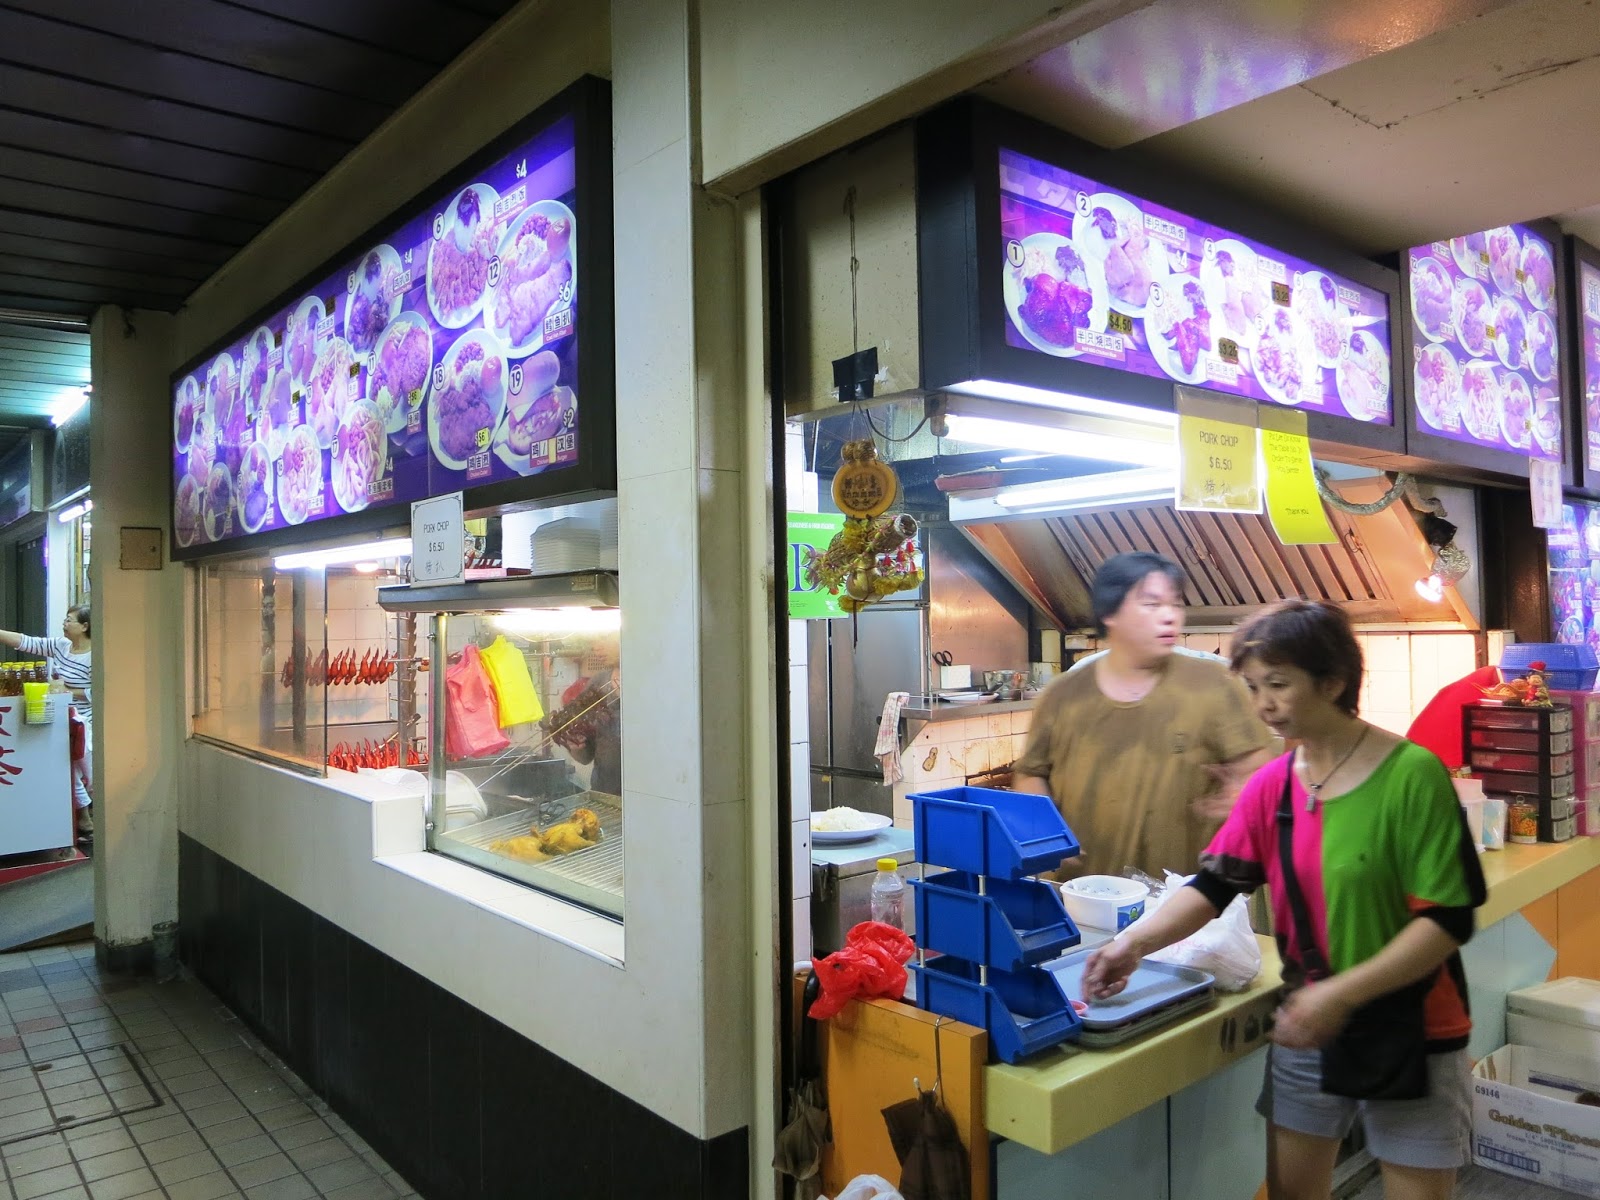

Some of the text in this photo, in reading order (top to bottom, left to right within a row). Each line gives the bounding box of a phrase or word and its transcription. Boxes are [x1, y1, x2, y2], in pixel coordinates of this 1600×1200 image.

[515, 158, 527, 179] $4
[559, 280, 571, 302] $6
[1109, 313, 1132, 332] $4.50
[563, 407, 575, 429] $2
[1199, 430, 1239, 448] PORK CHOP
[1208, 457, 1233, 471] $6.50
[423, 520, 450, 534] PORK CHOP
[428, 541, 445, 553] $6.50
[790, 543, 820, 592] B
[1474, 1085, 1500, 1099] G9146
[1488, 1108, 1542, 1134] Golden
